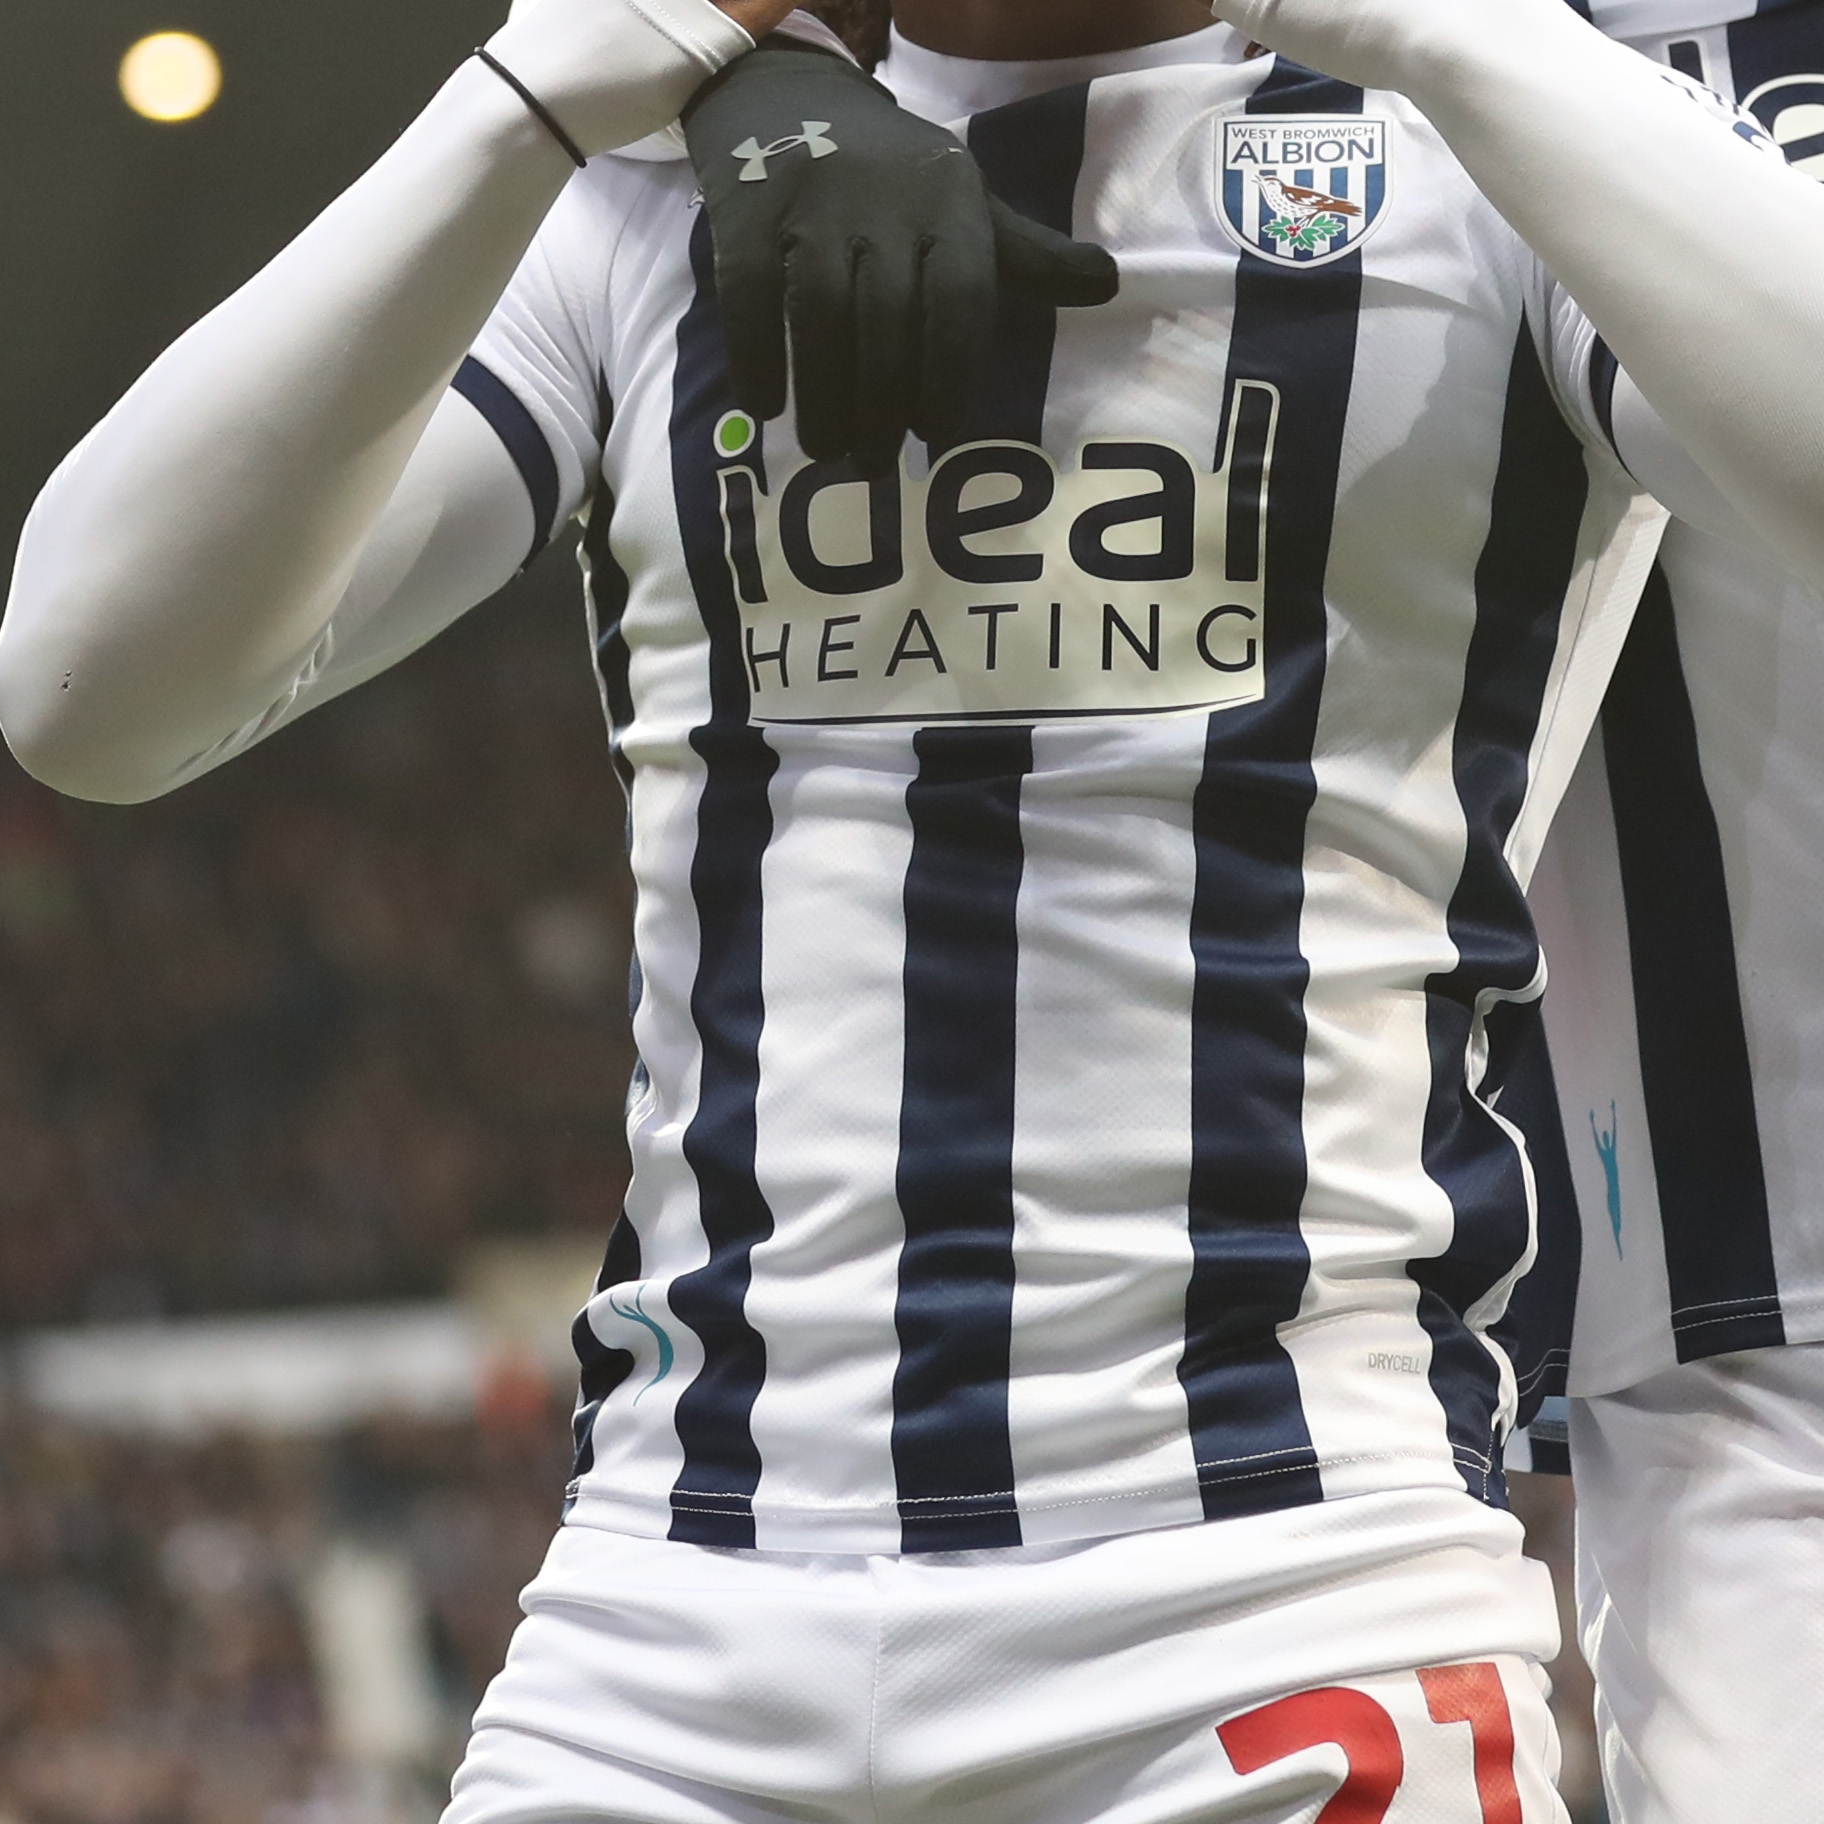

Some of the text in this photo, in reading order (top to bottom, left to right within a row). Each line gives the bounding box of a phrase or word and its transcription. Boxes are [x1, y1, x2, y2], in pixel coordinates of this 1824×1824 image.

[1231, 125, 1375, 140] WEST BROMWICH
[1231, 137, 1375, 164] ALBION
[714, 379, 1280, 605] ideal
[745, 603, 1258, 693] HEATING
[1367, 1352, 1421, 1374] DRYCELL
